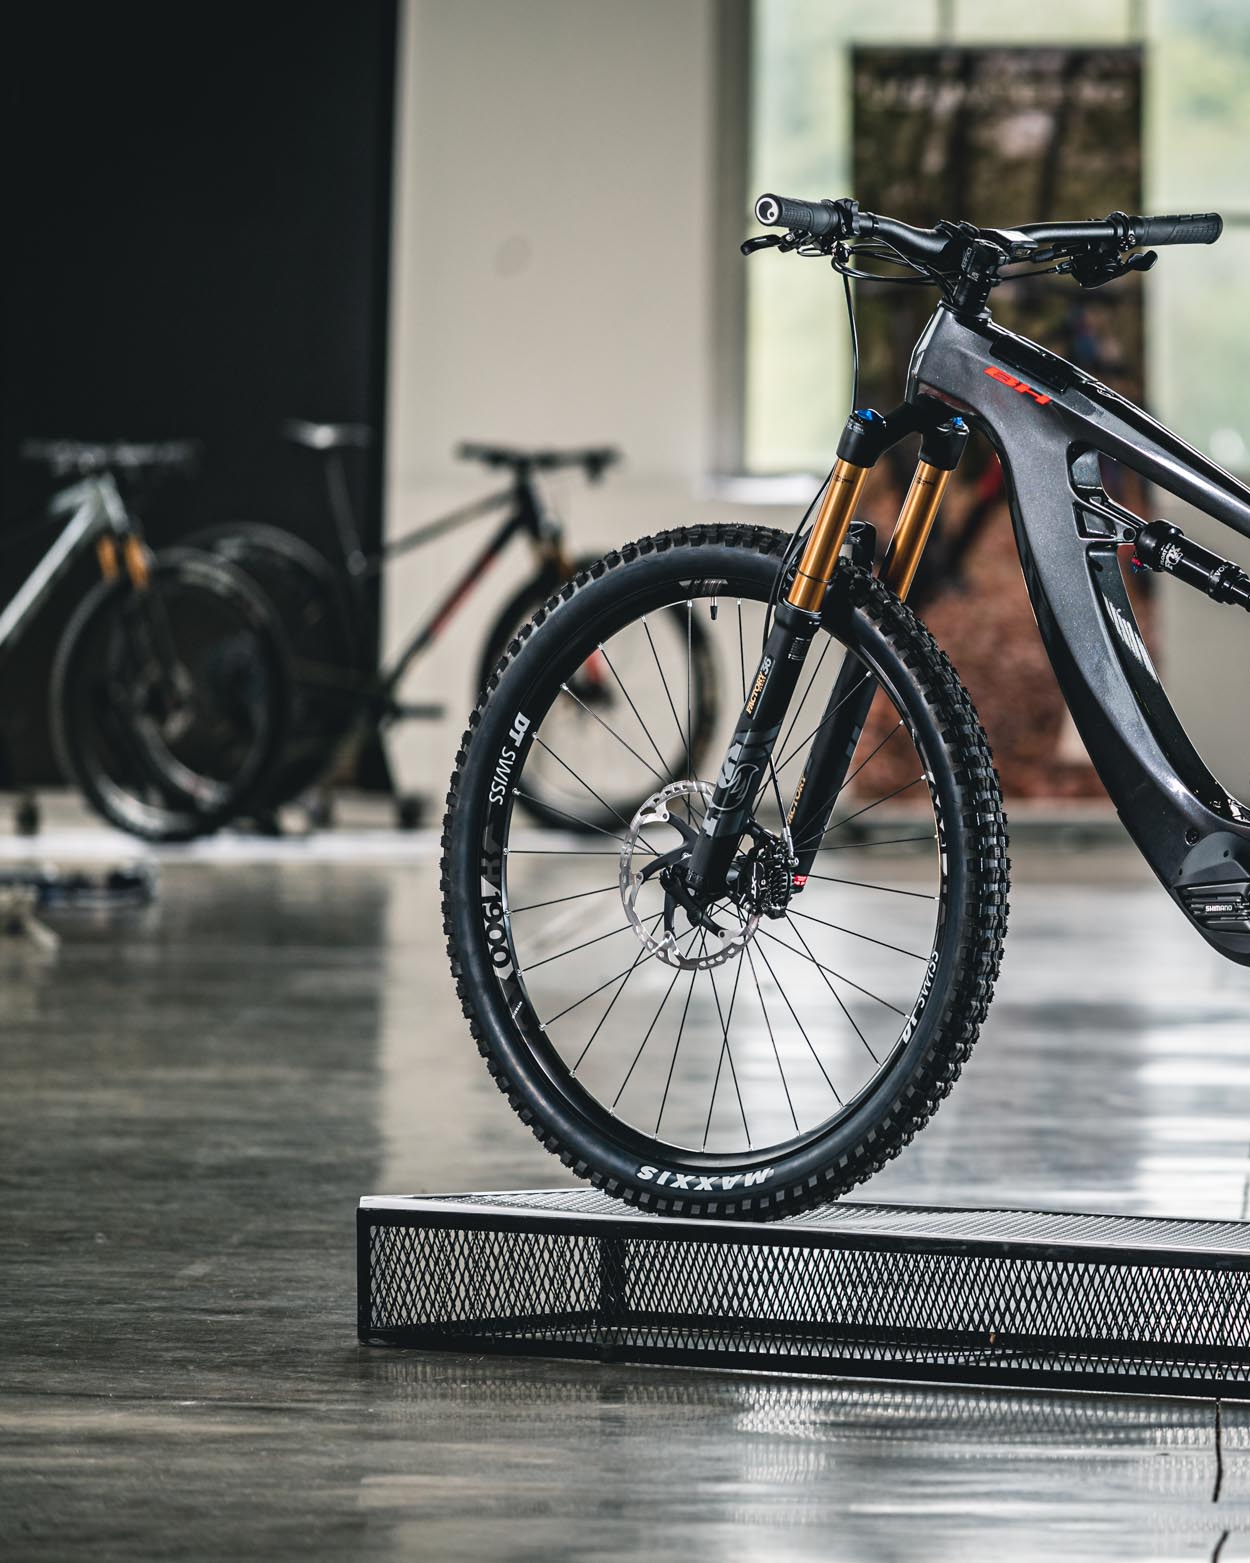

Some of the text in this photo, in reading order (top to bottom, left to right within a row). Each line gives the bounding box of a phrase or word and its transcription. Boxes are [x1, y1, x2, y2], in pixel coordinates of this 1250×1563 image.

[983, 365, 1053, 405] BH
[745, 670, 767, 714] FACTORY
[761, 656, 772, 676] 36
[489, 711, 530, 805] DT SWISS
[787, 776, 806, 825] ACTORY
[483, 888, 512, 969] 1900
[1205, 904, 1233, 913] SHIMANO
[637, 1165, 774, 1191] MAXXIS
